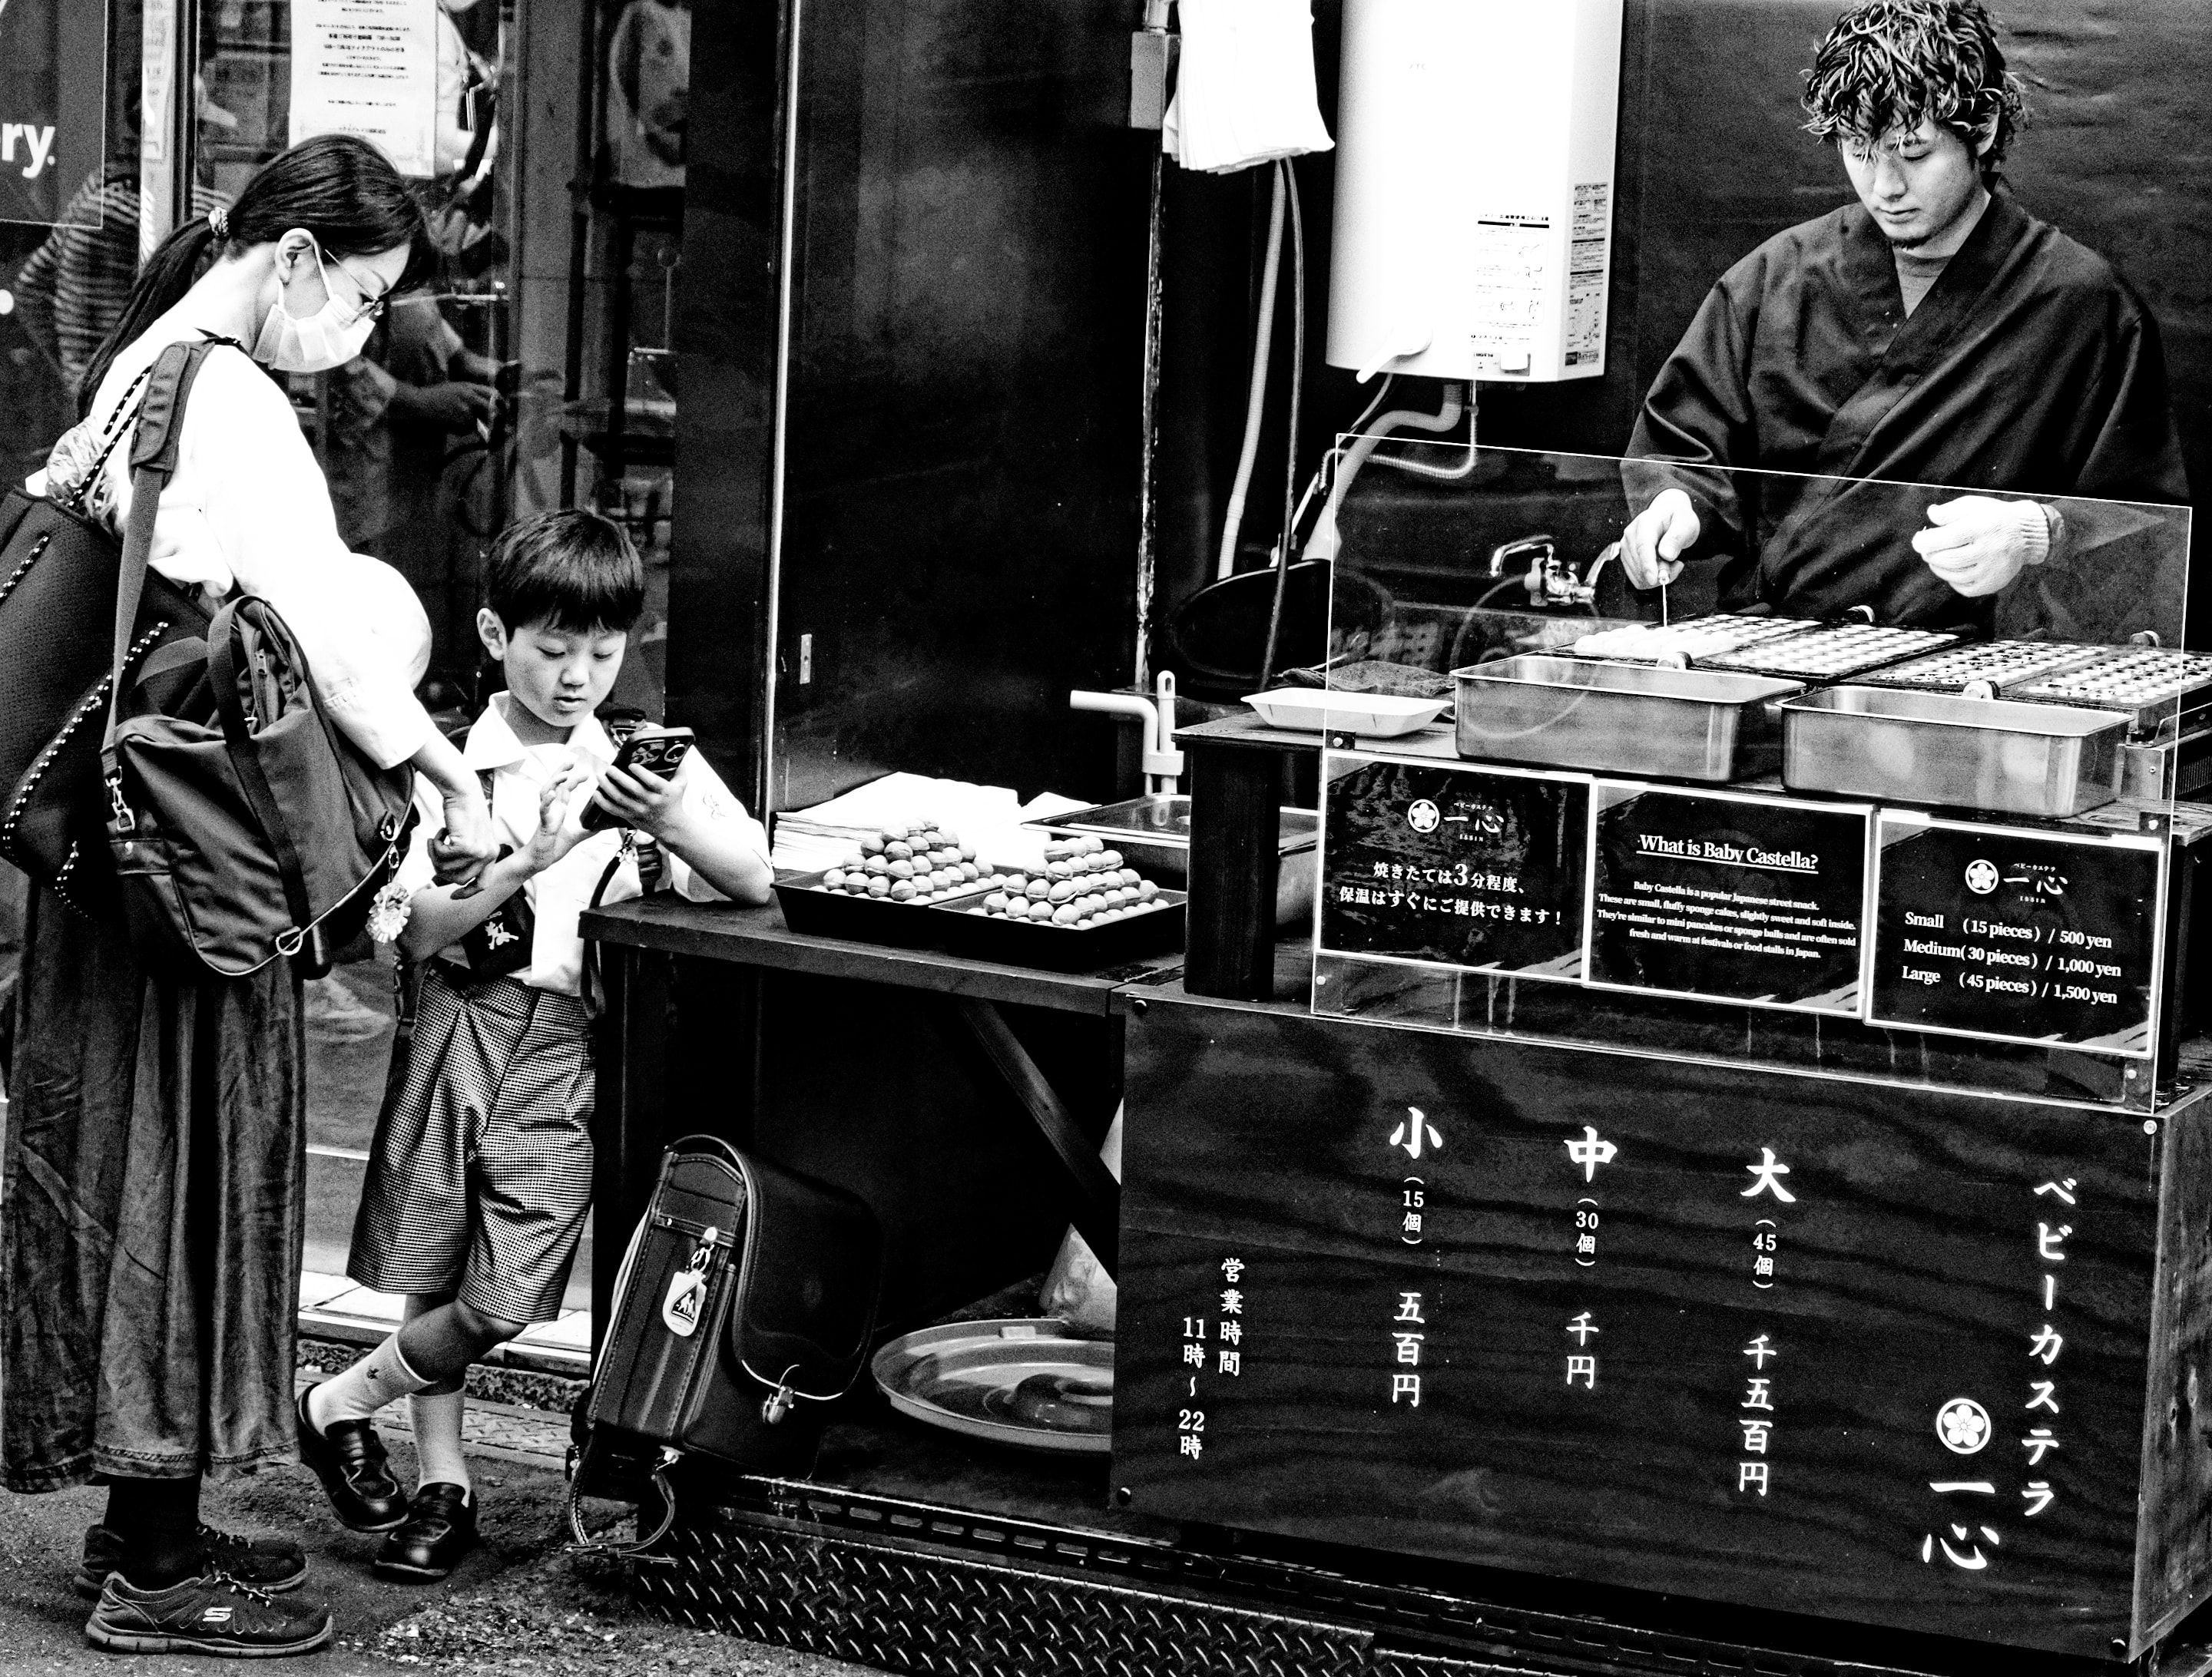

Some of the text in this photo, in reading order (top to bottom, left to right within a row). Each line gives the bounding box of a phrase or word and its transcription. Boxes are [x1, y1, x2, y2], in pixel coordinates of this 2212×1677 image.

[1444, 815, 1504, 832] 一心
[1640, 835, 1818, 869] What is Baby Castella?
[1374, 862, 1524, 893] 焼きたては3分程度、
[1634, 882, 1654, 893] Baby
[1654, 884, 1686, 895] Castella
[1687, 887, 1695, 896] is
[1700, 891, 1733, 901] popular
[1732, 892, 1769, 905] Japanese
[1769, 898, 1793, 908] street
[1793, 901, 1820, 910] snack.
[2004, 875, 2068, 895] 一心
[1339, 886, 1561, 925] 保温はすぐにご提供できます！
[1598, 894, 1623, 904] These
[1637, 899, 1662, 909] small,
[1664, 901, 1685, 912] fluffy
[1686, 905, 1715, 915] sponge
[1715, 908, 1739, 918] cakes,
[1740, 910, 1770, 921] slightly
[1770, 915, 1793, 924] sweet
[1794, 917, 1810, 925] and
[1812, 918, 1827, 927] soft
[1829, 919, 1856, 929] inside.
[1597, 909, 1627, 921] They're
[1628, 913, 1657, 923] similar
[1667, 918, 1685, 927] mini
[1686, 921, 1724, 931] pancakes
[1734, 928, 1763, 937] sponge
[1764, 928, 1784, 938] balls
[1816, 934, 1837, 944] often
[1838, 938, 1856, 946] sold
[1630, 928, 1650, 938] fresh
[1651, 932, 1667, 941] and
[1667, 934, 1691, 943] warm
[1701, 937, 1734, 948] festivals
[1743, 942, 1762, 952] food
[1763, 945, 1784, 954] stalls
[1786, 947, 1794, 955] in
[1795, 948, 1821, 958] Japan.
[1905, 912, 1944, 928] Small
[2060, 931, 2085, 944] 500
[2085, 936, 2111, 949] yen
[1903, 939, 1962, 958] Medium
[2058, 958, 2094, 973] 1,000
[2096, 964, 2121, 977] yen
[1902, 966, 1940, 984] Large
[2055, 984, 2090, 1001] 1,500
[2092, 991, 2117, 1004] yen
[1219, 1258, 1244, 1376] 営業時間
[1392, 1293, 1425, 1407] 五百円
[1566, 1312, 1599, 1389] 千円
[2022, 1178, 2077, 1516] ベビーカステラ
[1740, 1335, 1777, 1496] 千五百円
[1922, 1482, 1999, 1570] 一心
